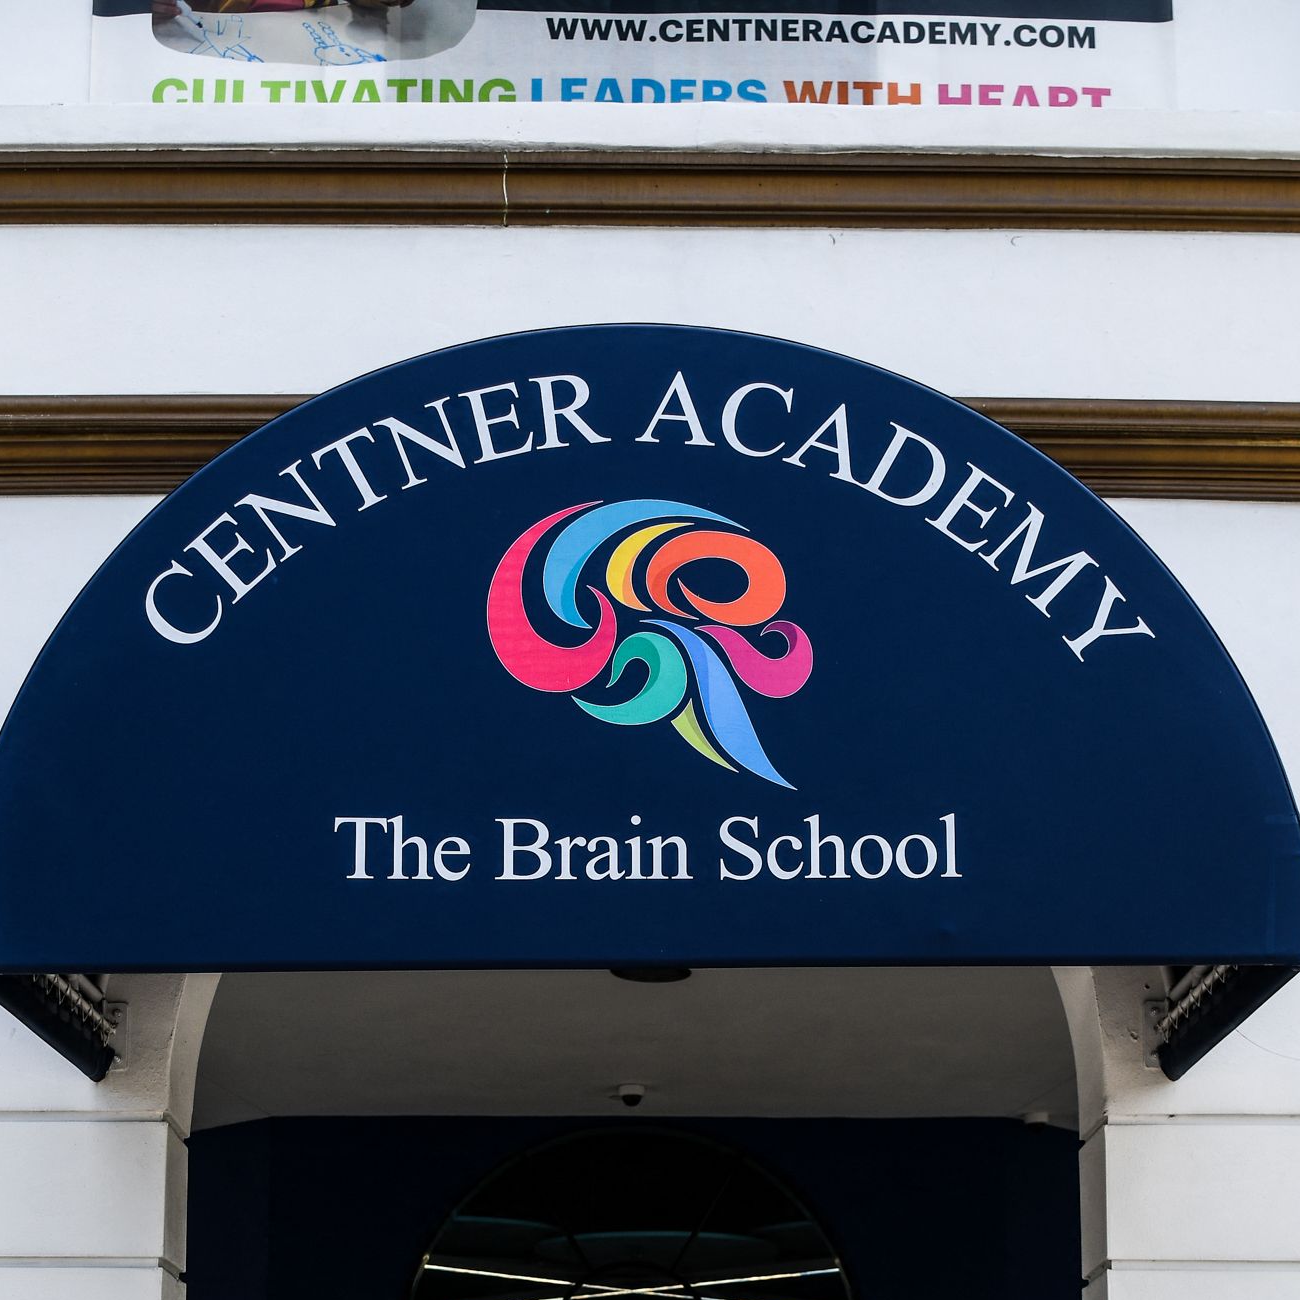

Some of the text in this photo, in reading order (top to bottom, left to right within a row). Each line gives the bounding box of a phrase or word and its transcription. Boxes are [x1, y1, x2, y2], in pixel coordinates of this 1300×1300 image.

[546, 17, 1096, 49] WWW.CENTNERACADEMY.COM
[145, 371, 1156, 662] CENTNER ACADEMY
[334, 812, 962, 881] The Brain School
